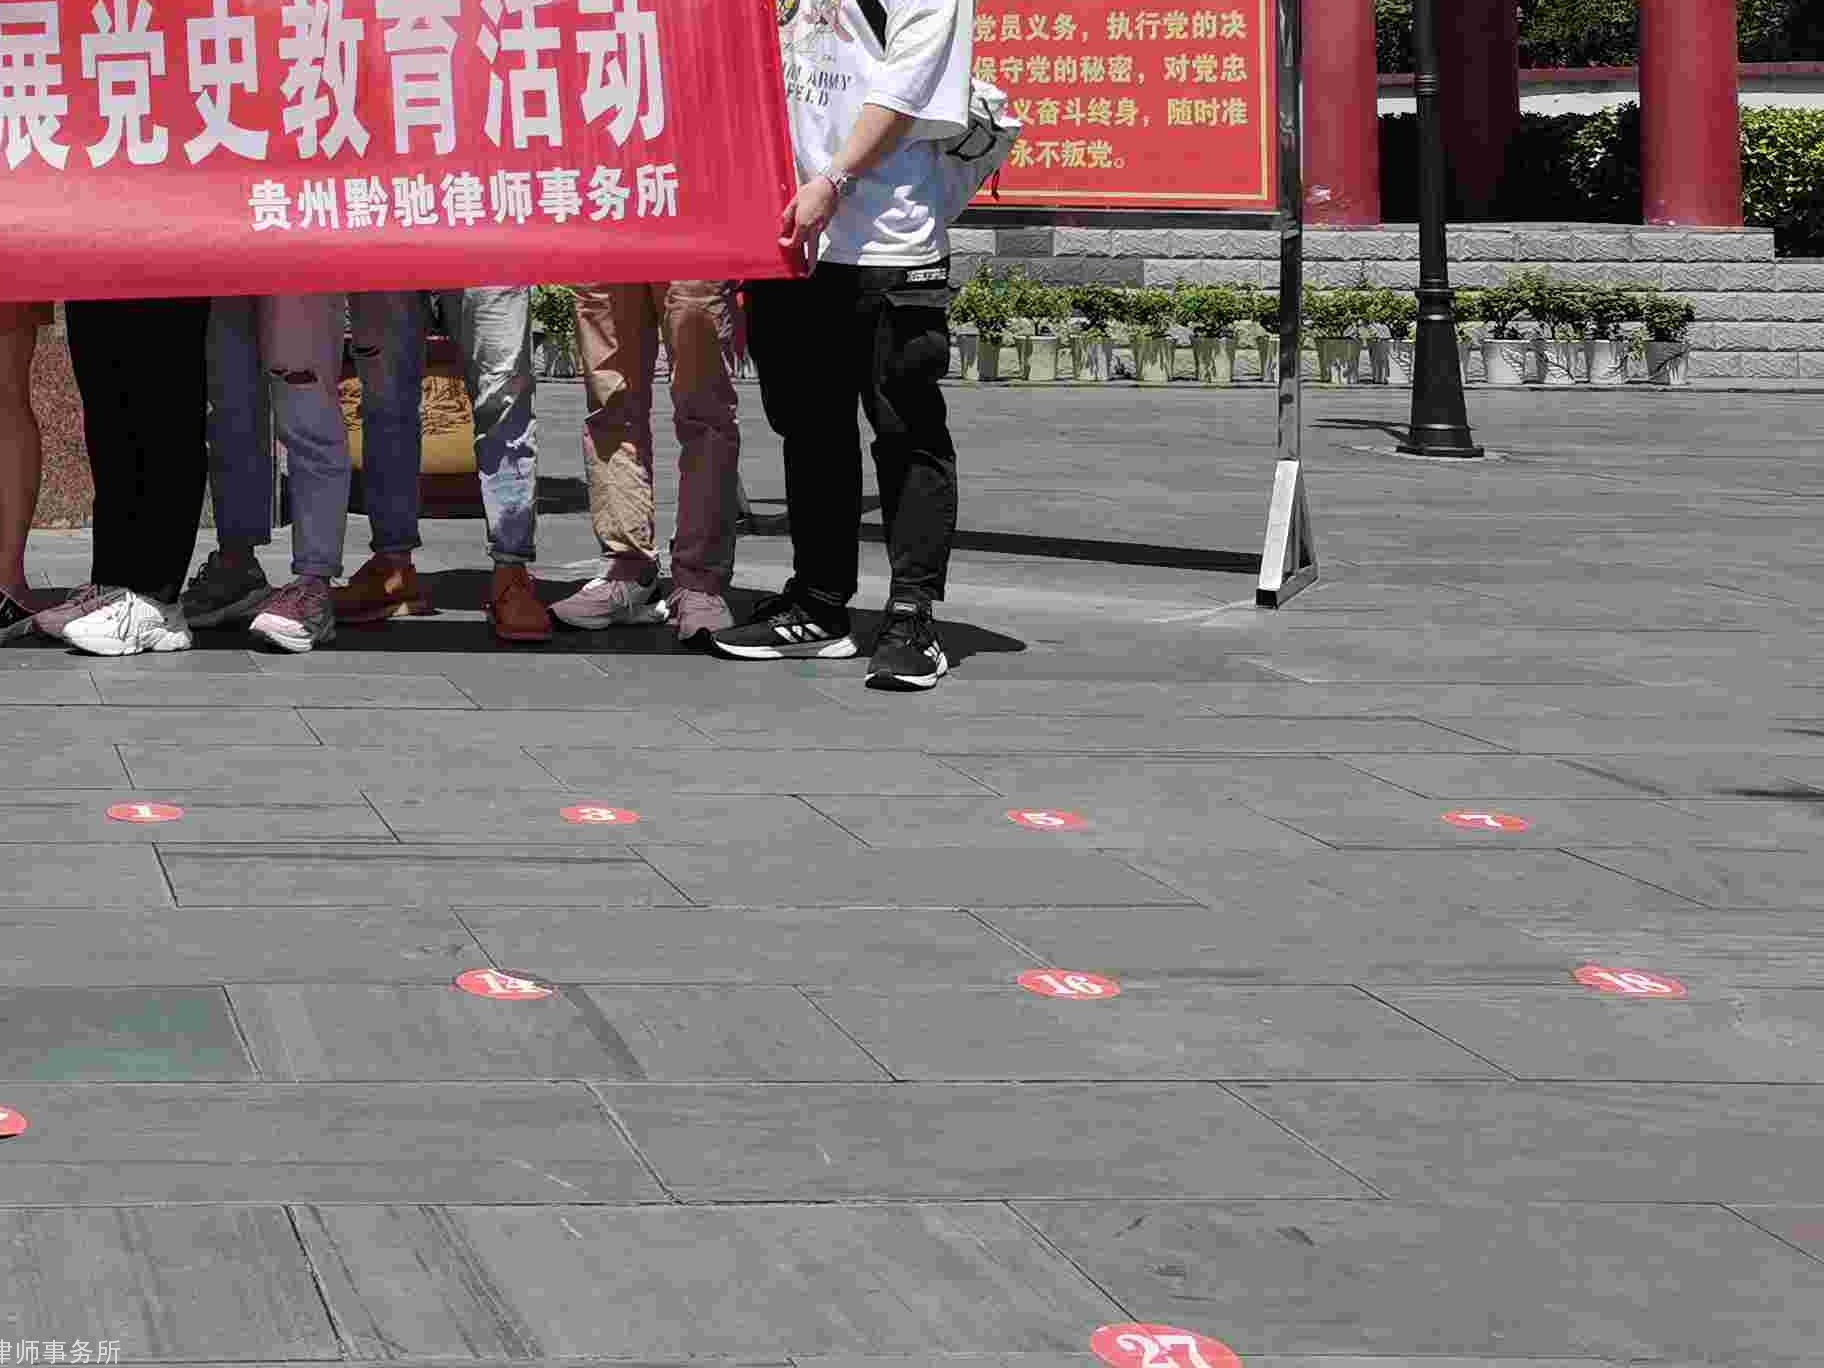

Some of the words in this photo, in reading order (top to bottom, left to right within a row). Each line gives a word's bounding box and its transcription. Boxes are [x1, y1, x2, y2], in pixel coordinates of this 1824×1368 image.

[248, 162, 680, 233] 贵州黔驰律师事务所
[577, 808, 616, 822] 3
[1456, 813, 1503, 828] 7
